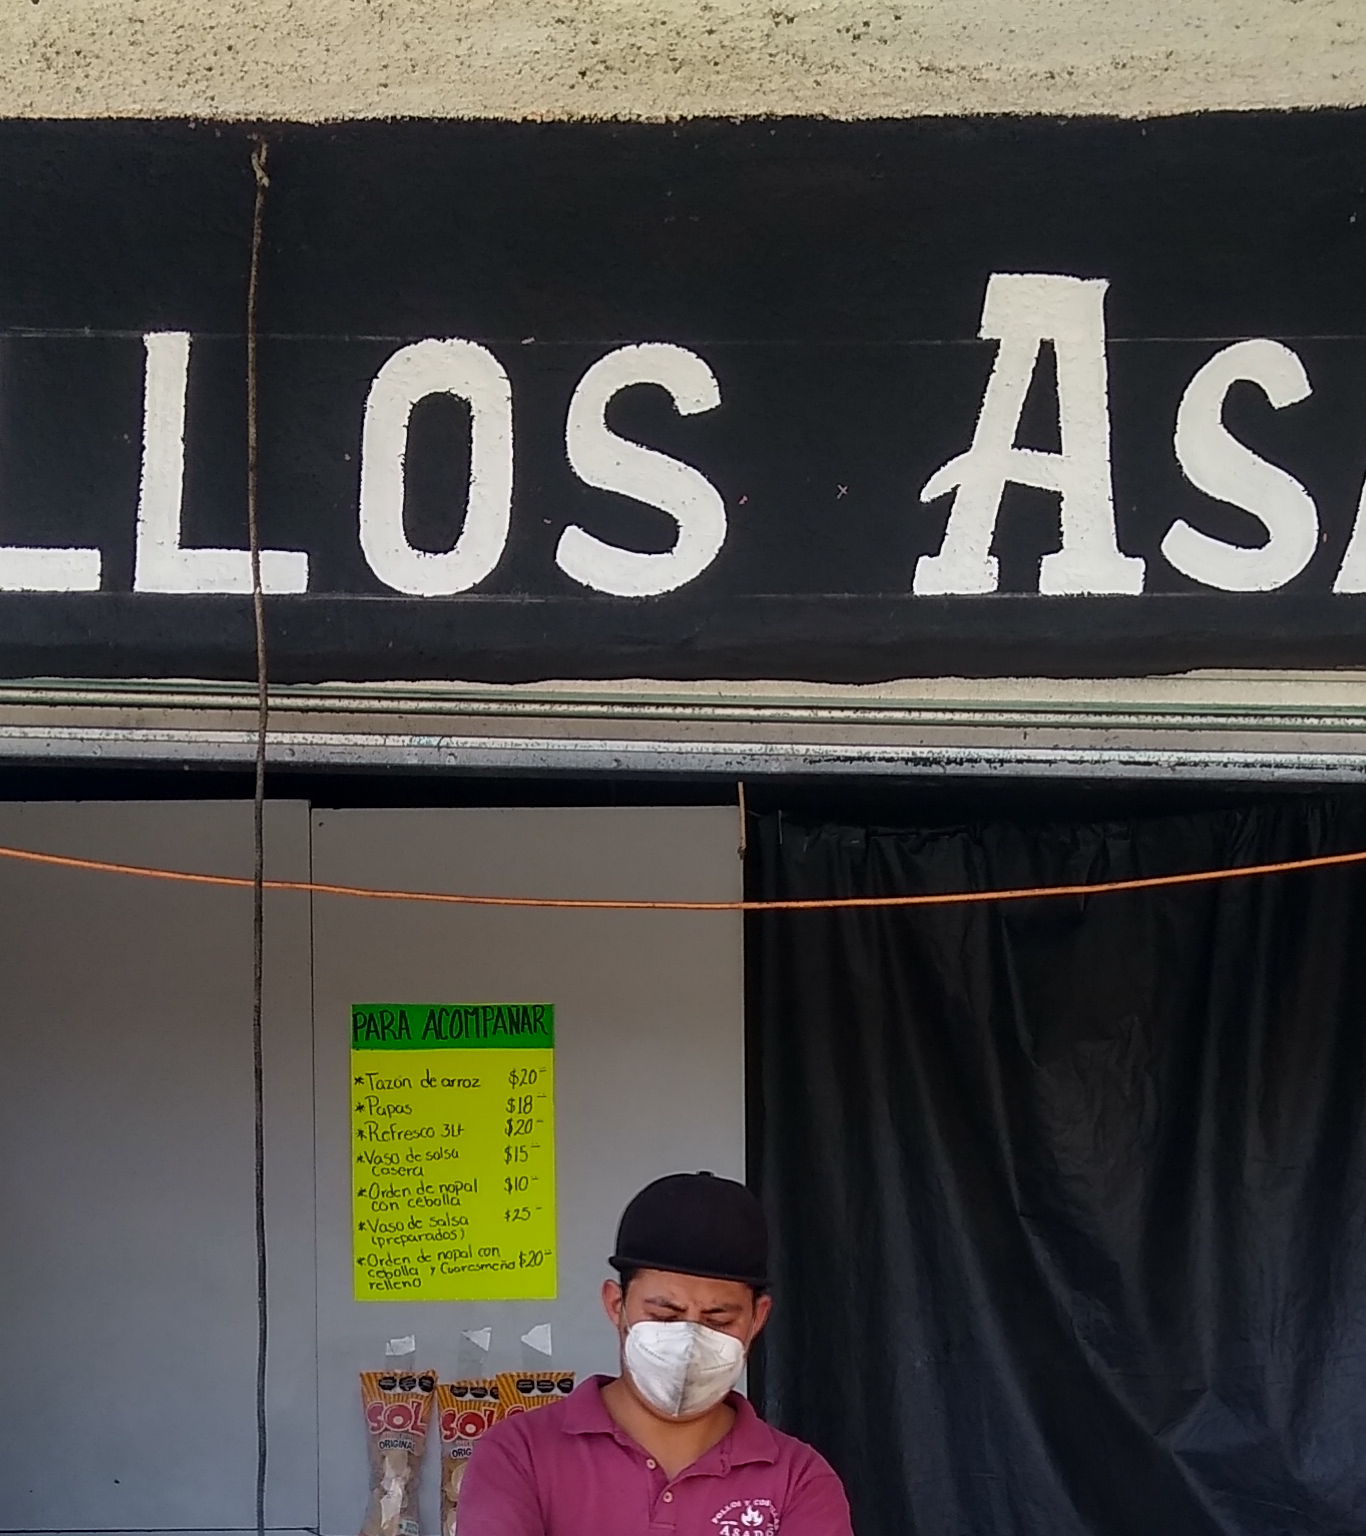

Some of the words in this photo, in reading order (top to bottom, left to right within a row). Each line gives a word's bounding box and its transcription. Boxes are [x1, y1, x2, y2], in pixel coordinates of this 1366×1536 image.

[352, 1010, 412, 1042] PARA
[420, 1068, 437, 1089] de
[441, 1076, 481, 1089] arroz
[364, 1095, 413, 1118] Papas
[364, 1120, 435, 1142] Refresco
[363, 1149, 400, 1166] Vaso
[405, 1147, 422, 1163] de
[425, 1147, 459, 1160] salsa
[371, 1165, 424, 1177] casera
[368, 1181, 411, 1200] Orden
[416, 1181, 434, 1196] de
[439, 1177, 478, 1196] nopal
[371, 1200, 399, 1213] con
[407, 1194, 461, 1209] cebolla
[367, 1218, 404, 1233] Vaso
[407, 1215, 423, 1230] de
[429, 1212, 469, 1227] salsa
[371, 1228, 465, 1249] (preparados)
[367, 1253, 411, 1268] Orden
[417, 1248, 432, 1263] de
[437, 1244, 473, 1262] nopal
[478, 1246, 501, 1259] con
[367, 1264, 419, 1280] cebolla
[369, 1277, 422, 1291] relleno
